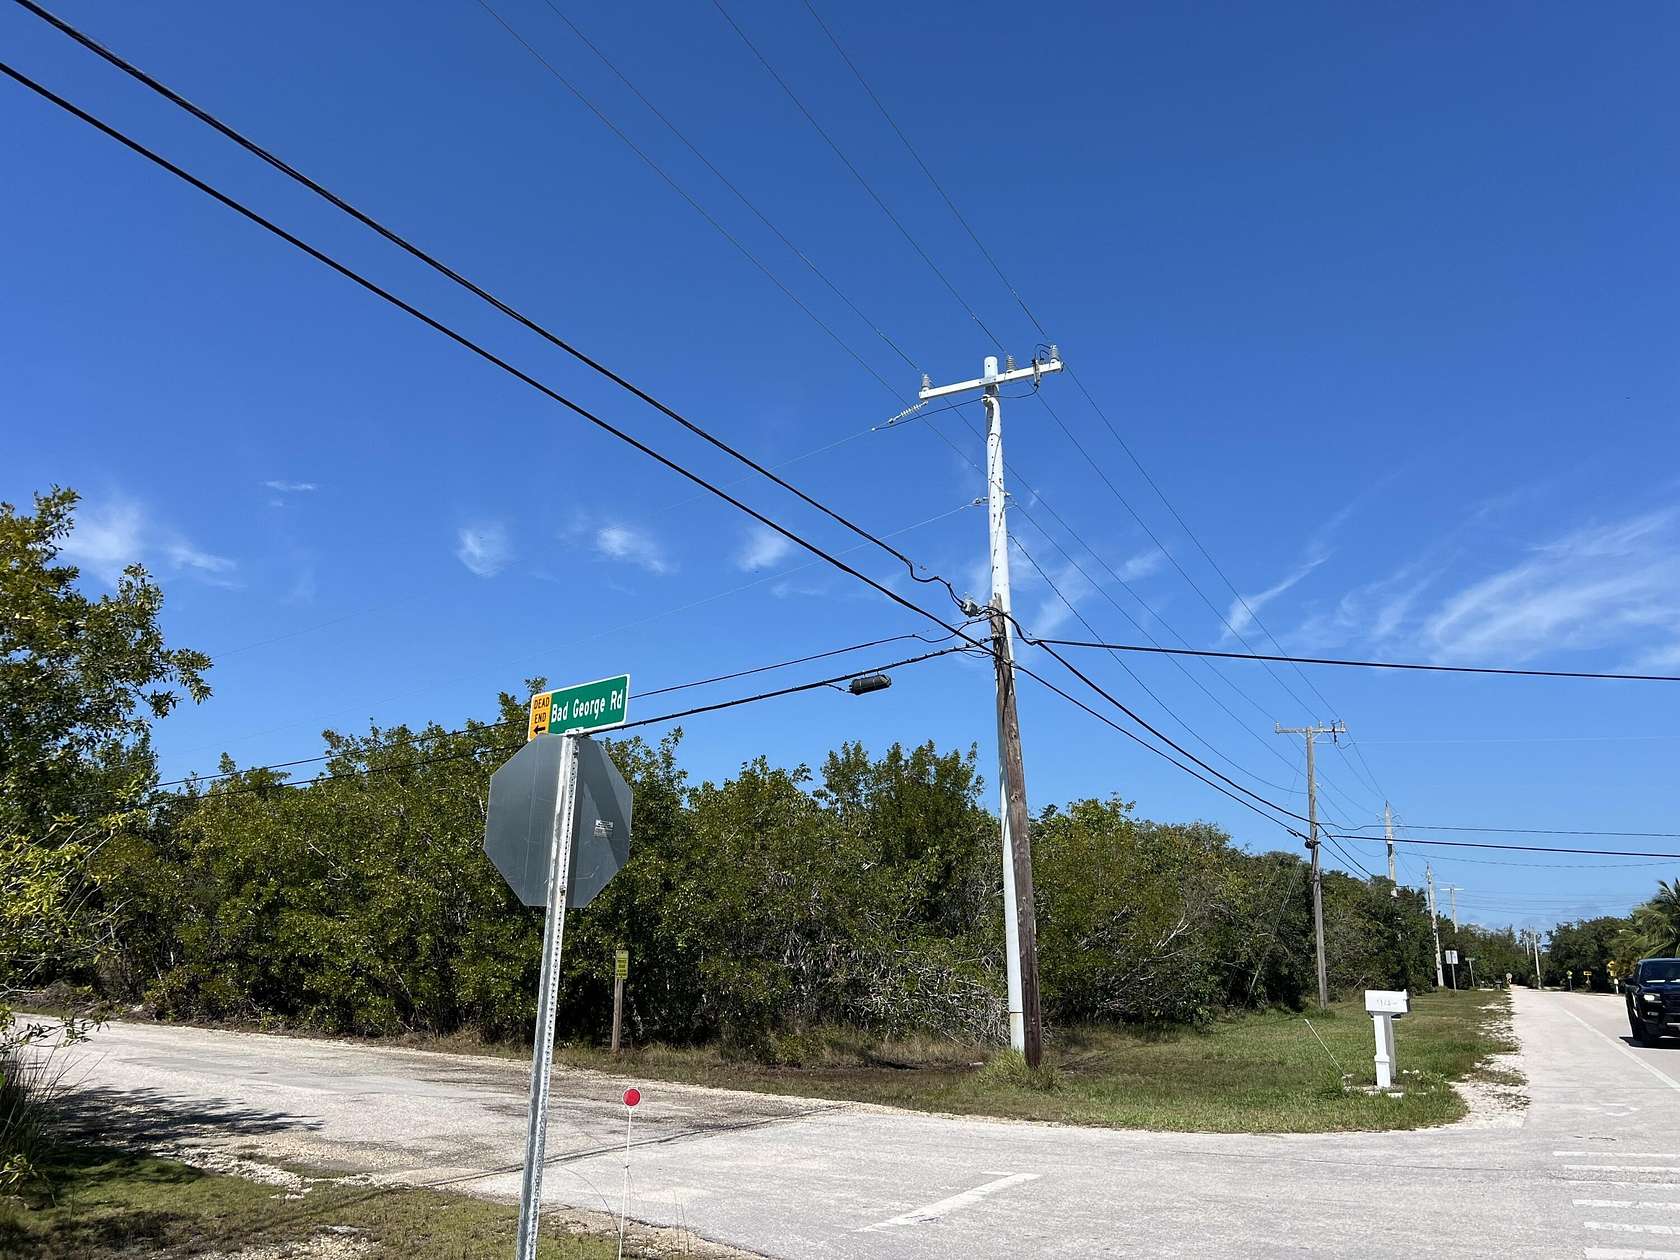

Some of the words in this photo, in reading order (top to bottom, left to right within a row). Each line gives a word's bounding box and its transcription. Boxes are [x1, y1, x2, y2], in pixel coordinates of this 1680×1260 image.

[533, 696, 550, 710] DEAD
[551, 702, 568, 723] Bad
[573, 697, 605, 720] George
[610, 689, 623, 711] Rd
[534, 712, 547, 724] END
